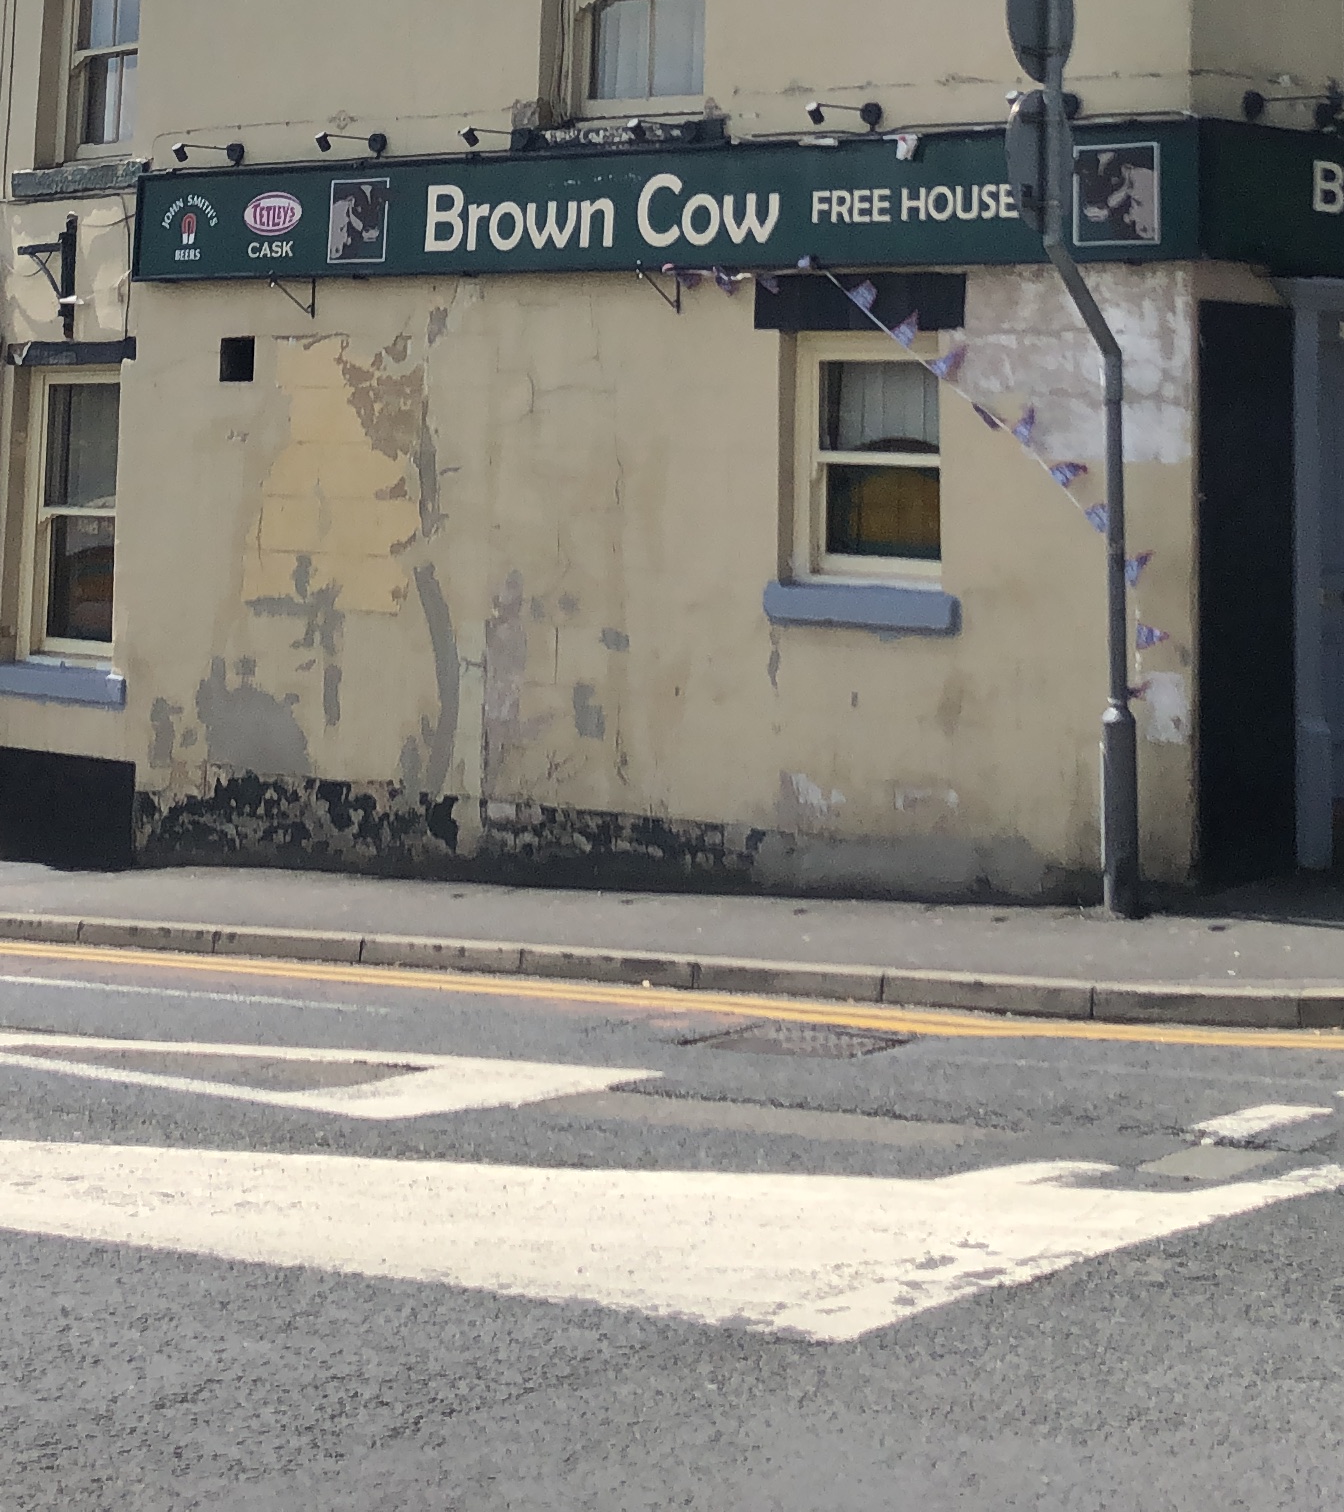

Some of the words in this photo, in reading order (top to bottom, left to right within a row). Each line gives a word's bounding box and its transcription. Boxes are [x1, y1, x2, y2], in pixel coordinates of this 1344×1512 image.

[161, 198, 184, 230] JOHN
[187, 194, 218, 227] SMITH'S
[251, 201, 296, 228] TETLEY'S
[424, 184, 614, 252] Brown
[637, 173, 780, 246] Cow
[811, 189, 891, 224] FREE
[901, 184, 1020, 222] HOUSE
[174, 248, 201, 261] BEERS
[247, 240, 294, 258] CASK
